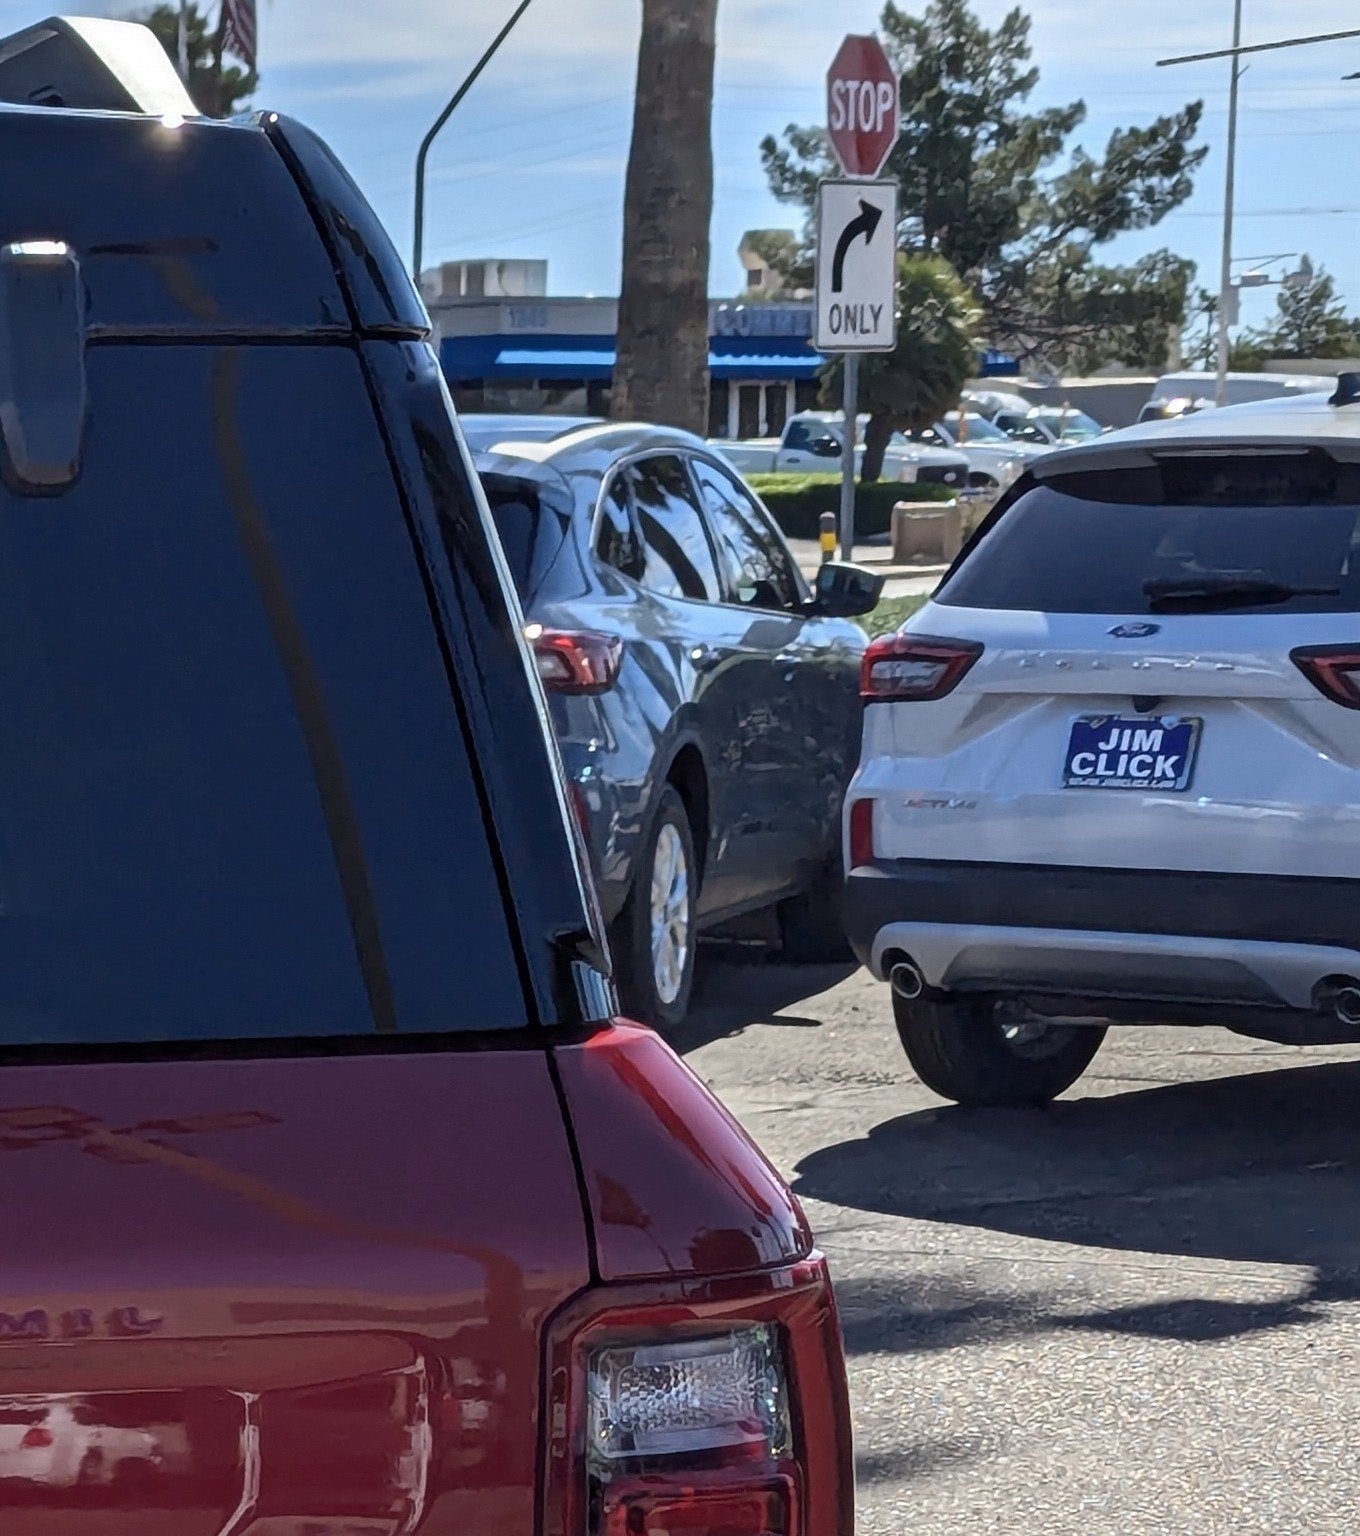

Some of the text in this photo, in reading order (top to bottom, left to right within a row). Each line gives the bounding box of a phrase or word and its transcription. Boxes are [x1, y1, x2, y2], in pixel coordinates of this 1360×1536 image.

[831, 78, 894, 132] STOP
[829, 303, 883, 335] ONLY
[1098, 728, 1164, 752] JIM
[1071, 752, 1180, 778] CLICK
